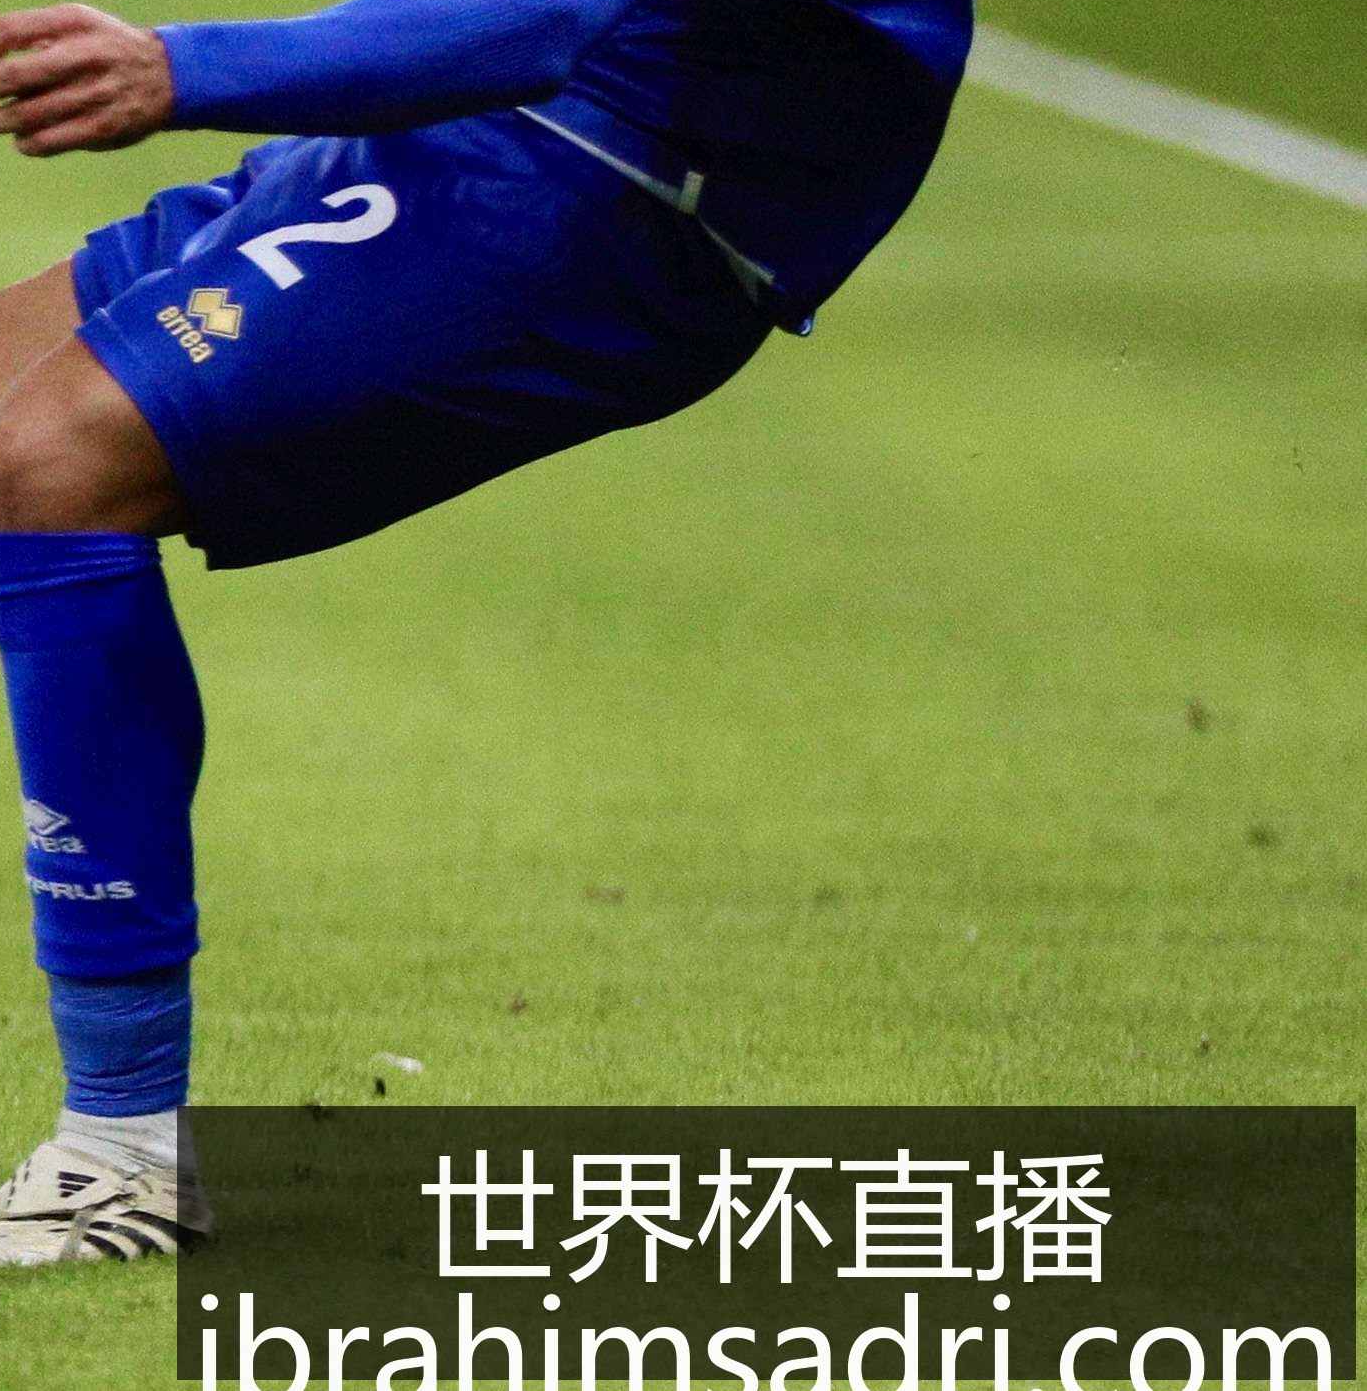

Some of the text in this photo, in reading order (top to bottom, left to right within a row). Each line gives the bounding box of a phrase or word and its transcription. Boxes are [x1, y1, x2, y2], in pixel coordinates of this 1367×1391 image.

[236, 183, 398, 291] 2
[156, 305, 214, 364] errea
[26, 873, 138, 901] PRUS
